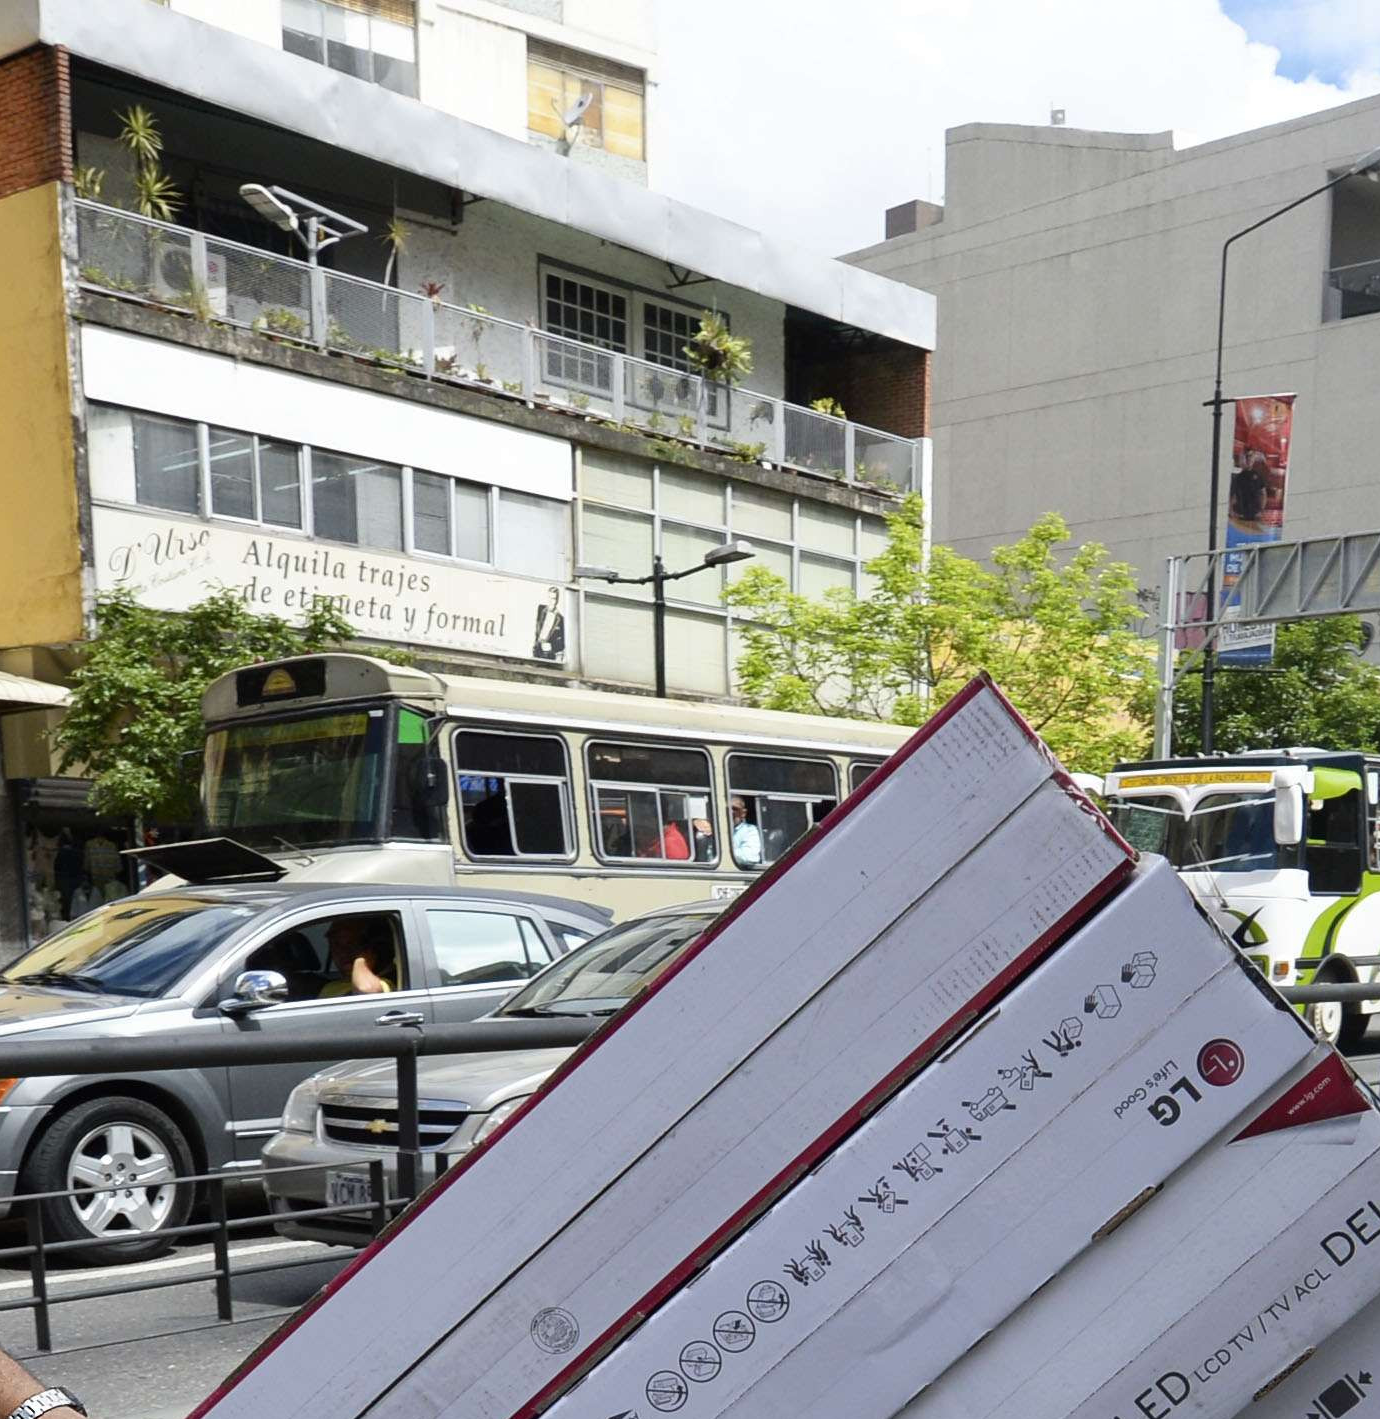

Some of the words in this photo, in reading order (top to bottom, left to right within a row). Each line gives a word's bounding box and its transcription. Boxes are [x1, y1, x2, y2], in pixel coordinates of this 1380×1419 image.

[242, 540, 346, 579] Alquila
[358, 561, 431, 599] trajes
[241, 576, 273, 604] de
[404, 606, 416, 632] y
[423, 603, 506, 638] formal
[1144, 1060, 1180, 1089] Life's
[1286, 1075, 1332, 1117] www.lg.com
[1113, 1086, 1147, 1120] Good
[1146, 1076, 1203, 1127] LG
[1193, 1348, 1232, 1384] LCD
[1228, 1325, 1256, 1352] TV
[1257, 1314, 1268, 1335] /
[1264, 1294, 1292, 1322] TV
[1292, 1268, 1332, 1303] ACL
